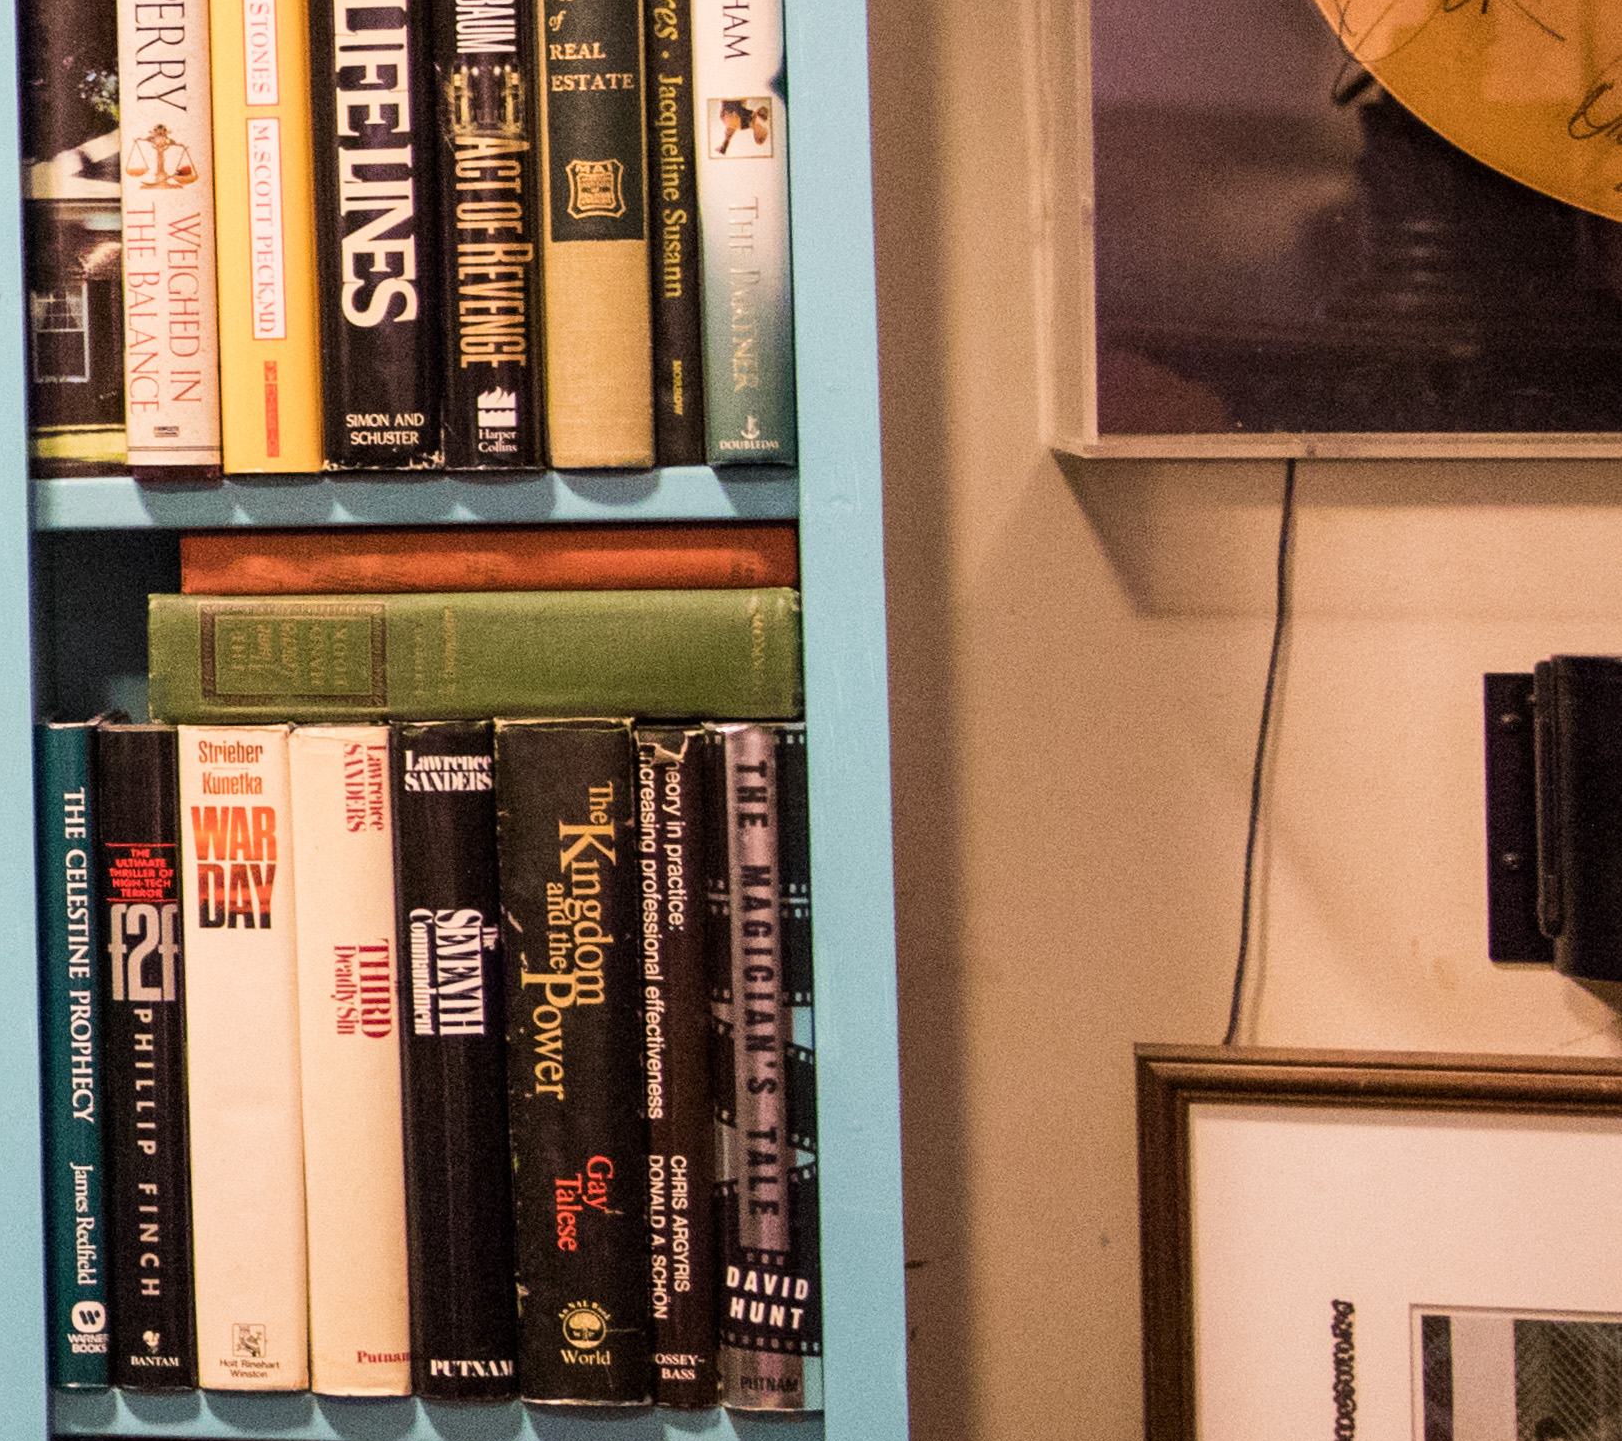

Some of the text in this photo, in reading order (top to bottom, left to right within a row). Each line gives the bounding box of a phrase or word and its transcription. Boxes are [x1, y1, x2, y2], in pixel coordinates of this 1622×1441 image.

[249, 3, 270, 95] STONES
[550, 44, 606, 60] REAL
[552, 74, 634, 92] ESTATE
[346, 413, 424, 427] SIMON AND
[350, 431, 419, 445] SCHUSTER
[198, 740, 263, 765] Strieber
[202, 772, 263, 795] Kunetka
[191, 806, 277, 861] WAR
[198, 863, 277, 928] DAY
[63, 787, 96, 1124] THE CELESTINE PROPHECY
[70, 1162, 97, 1285] James Redfield
[726, 1266, 810, 1300] DAVID
[730, 1296, 804, 1330] HUNT
[561, 1349, 611, 1366] World
